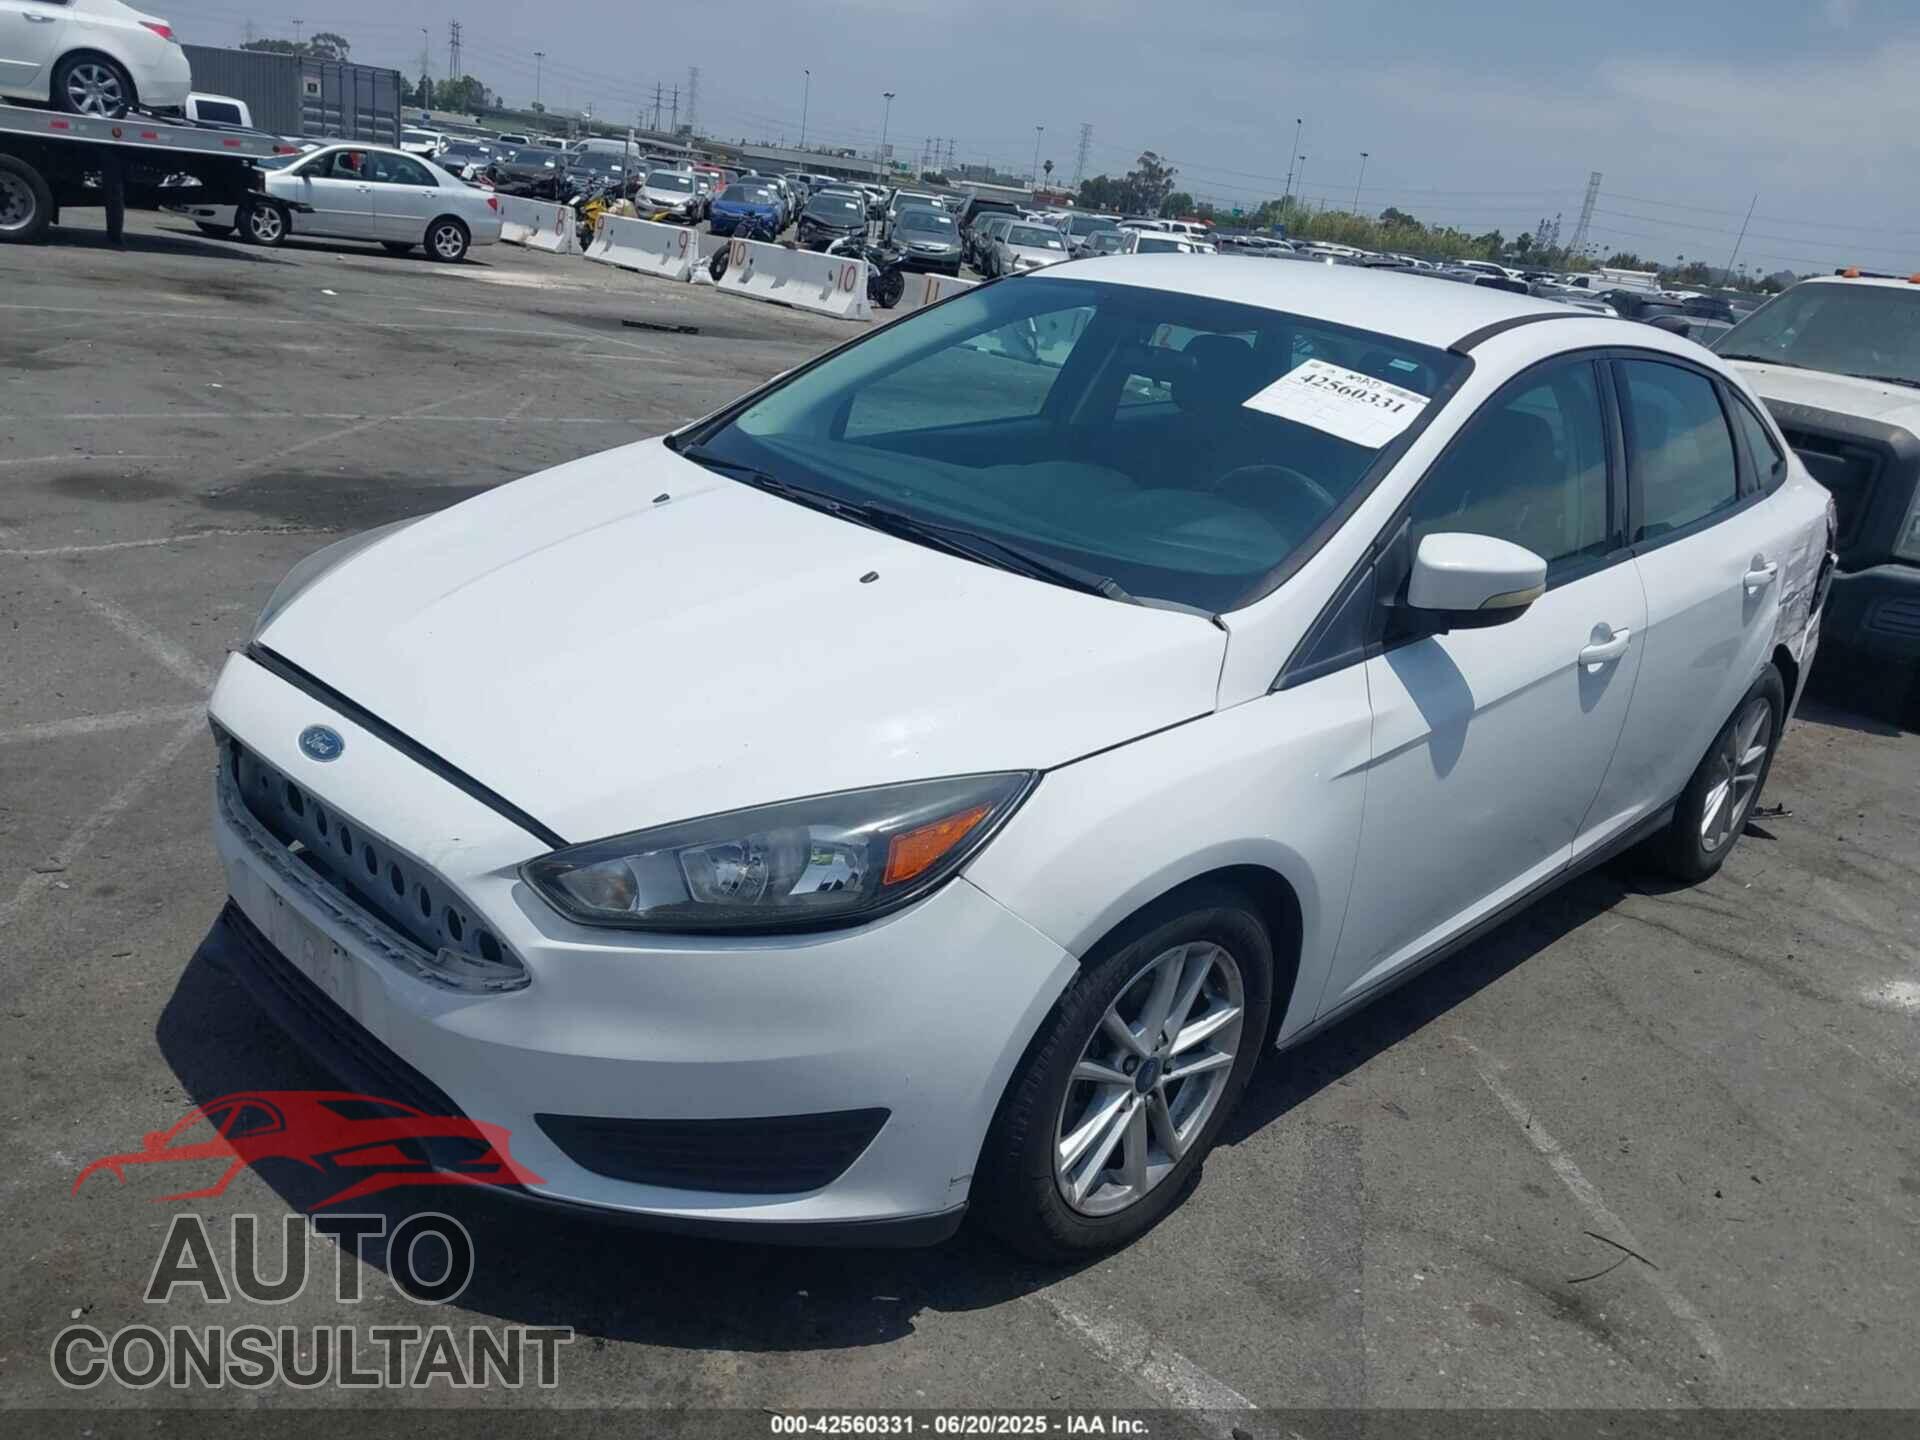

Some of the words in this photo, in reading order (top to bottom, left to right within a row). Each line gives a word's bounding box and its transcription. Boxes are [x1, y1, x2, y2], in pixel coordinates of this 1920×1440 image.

[555, 207, 566, 237] 8
[678, 229, 689, 259] 9
[730, 238, 746, 267] 10
[837, 262, 857, 293] 10
[1300, 373, 1406, 413] 42560331
